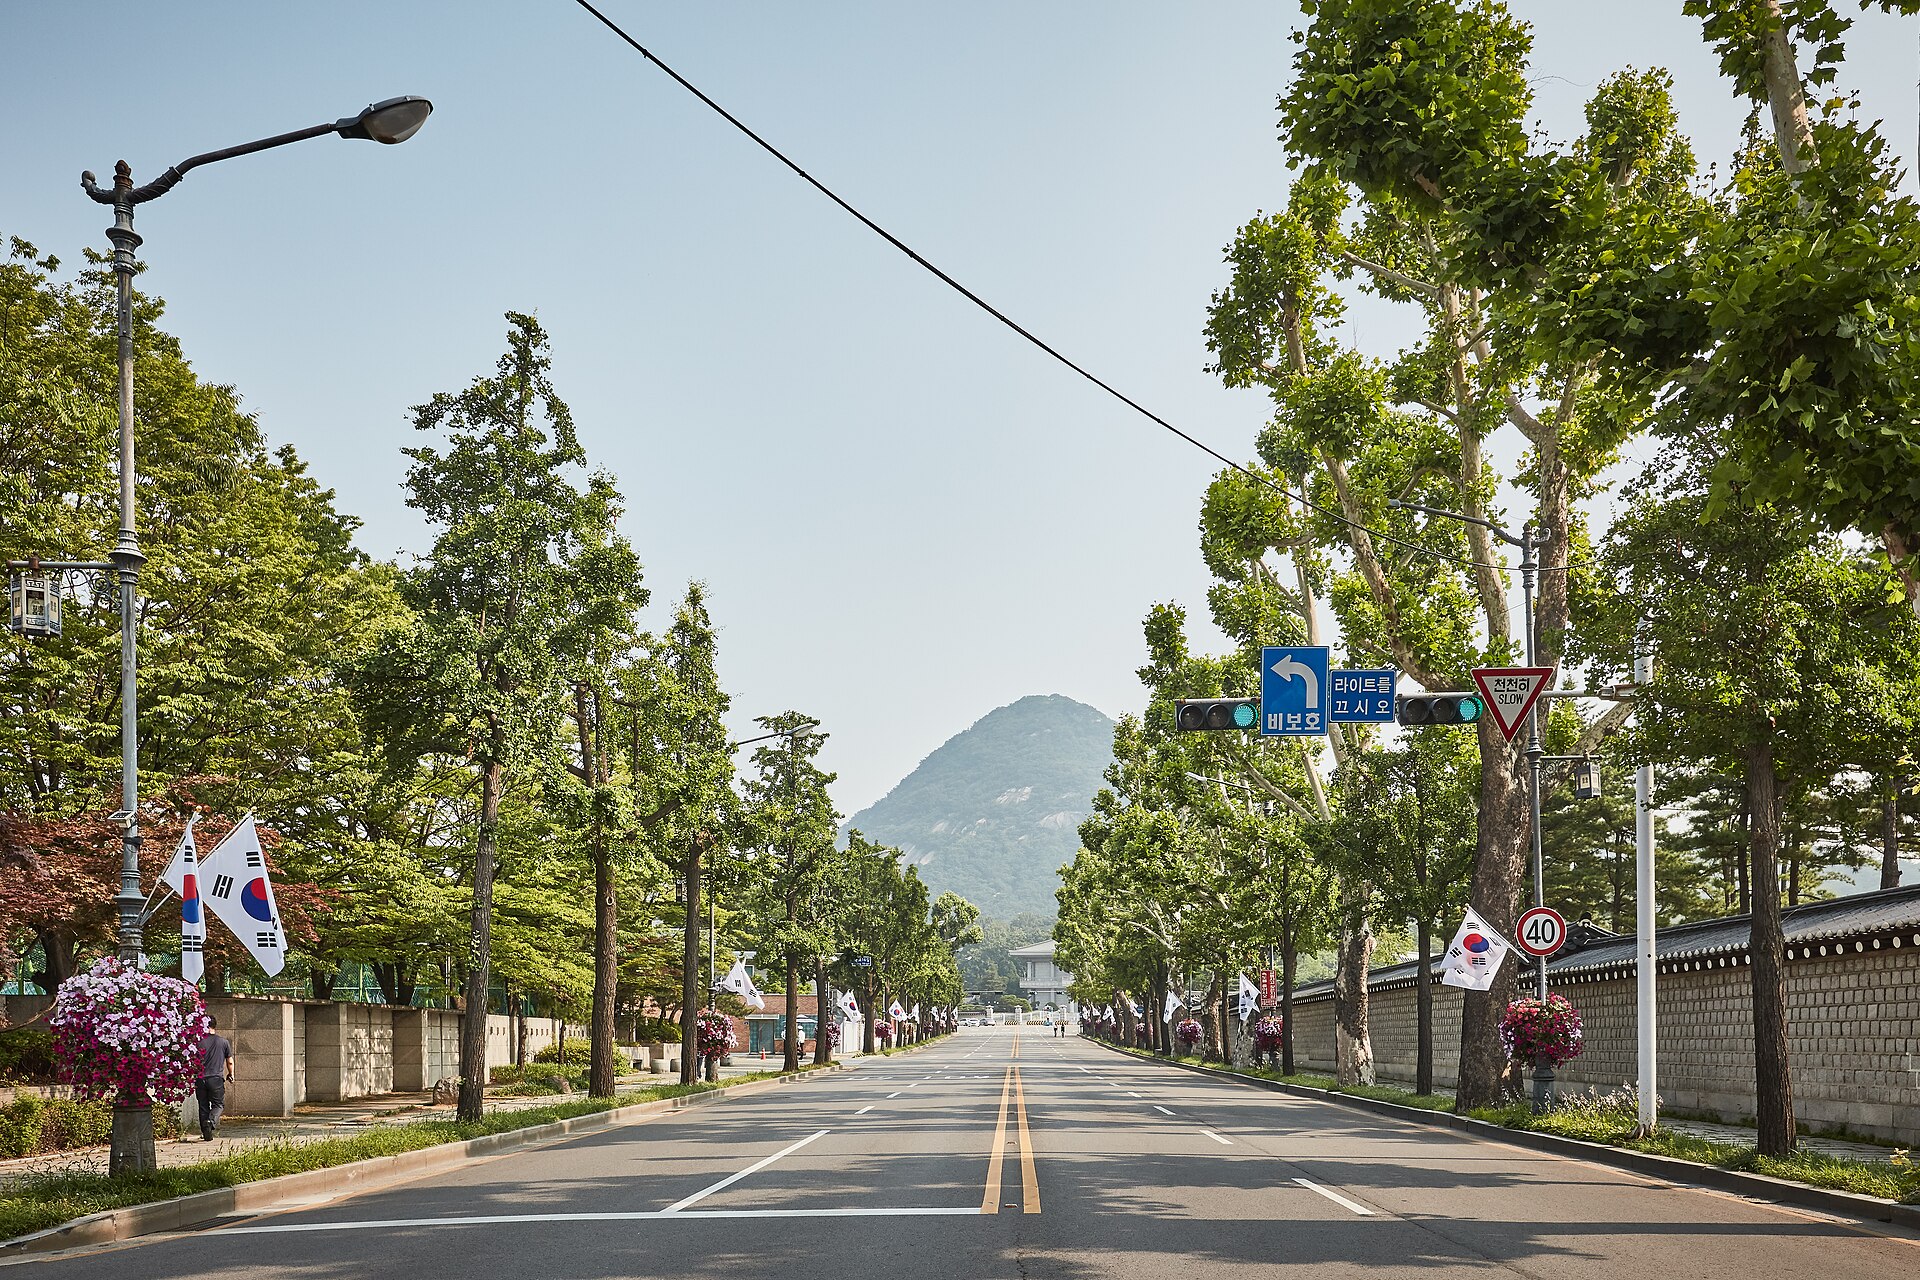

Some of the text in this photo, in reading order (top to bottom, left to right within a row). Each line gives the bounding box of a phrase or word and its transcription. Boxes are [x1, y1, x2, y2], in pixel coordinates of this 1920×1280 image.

[1335, 677, 1392, 693] 라이트를
[1494, 678, 1530, 692] 천천히
[1498, 694, 1524, 705] SLOW
[1267, 712, 1320, 731] 비보호
[1526, 919, 1555, 944] 40
